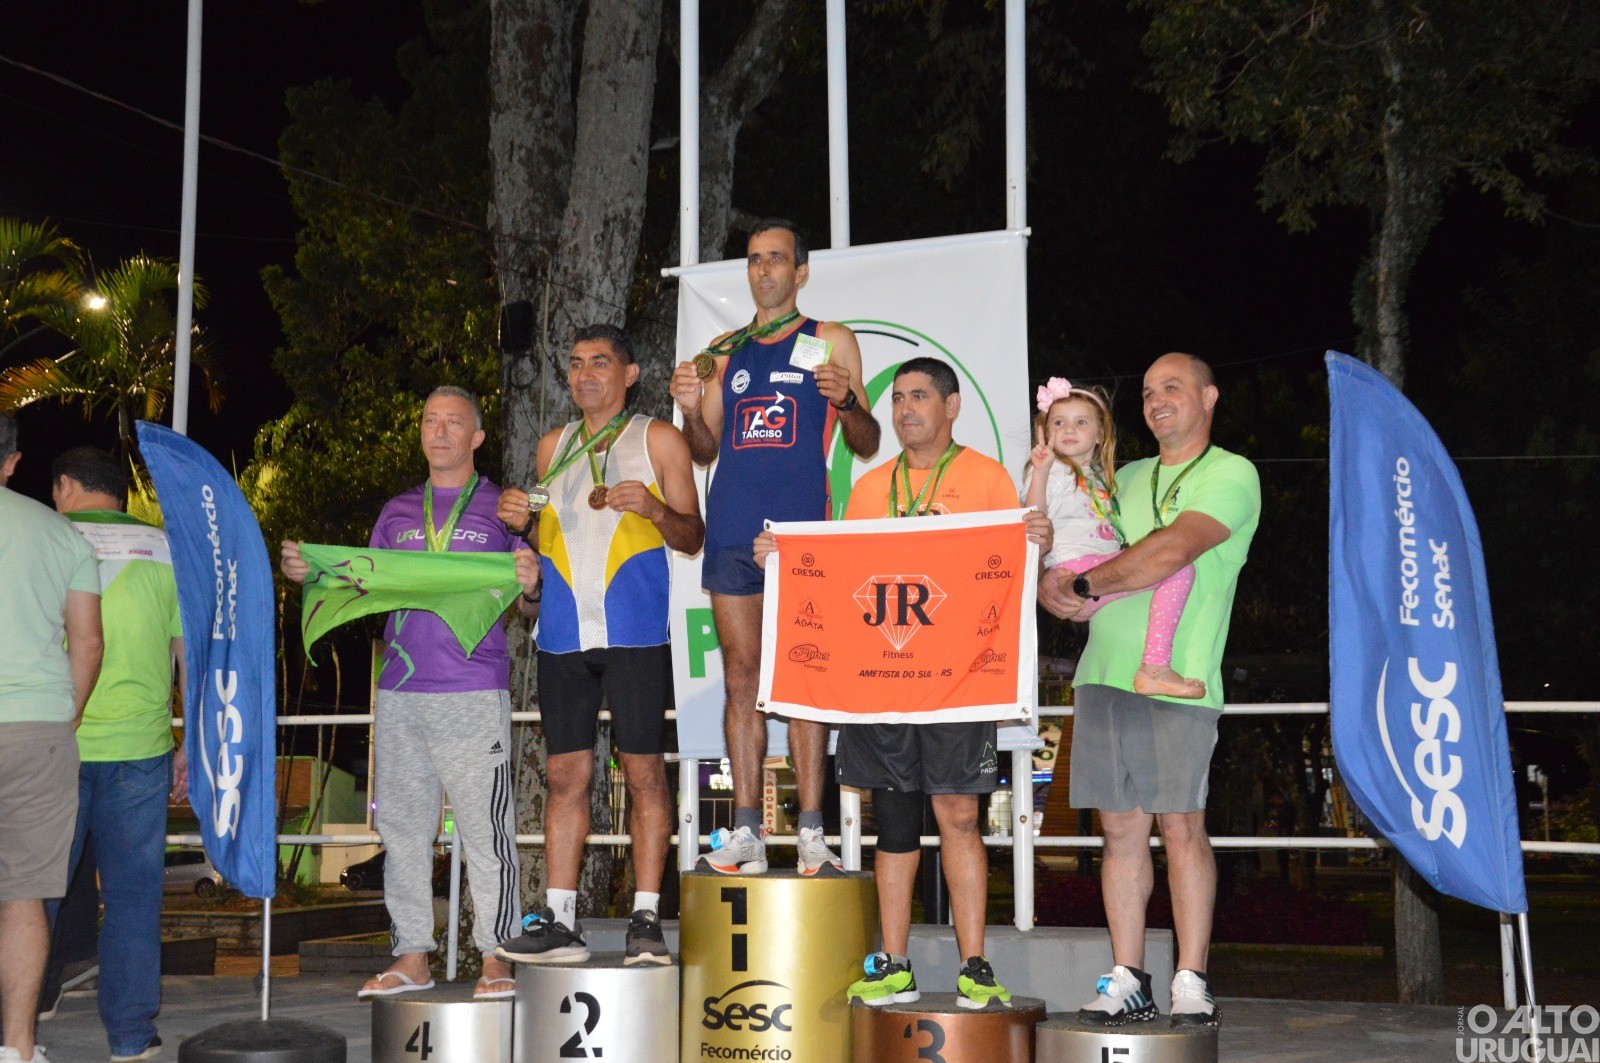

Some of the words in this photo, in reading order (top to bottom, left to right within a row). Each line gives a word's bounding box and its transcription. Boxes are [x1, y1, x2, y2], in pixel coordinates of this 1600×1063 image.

[742, 405, 786, 430] TAG
[742, 429, 782, 439] TARCISO
[1395, 457, 1420, 627] Fecomércio
[202, 484, 225, 640] Fecomércio
[792, 567, 826, 578] CRESOL
[975, 570, 1012, 580] CRESOL
[228, 558, 239, 641] Senac
[863, 582, 935, 626] JR
[1429, 538, 1455, 631] Senac
[794, 616, 824, 631] ÁGATA
[859, 669, 900, 678] AMETISTA
[902, 670, 915, 678] DO
[918, 670, 932, 678] SUL
[940, 669, 952, 677] RS
[883, 650, 914, 659] Fitness
[721, 887, 747, 971] 1
[405, 1021, 433, 1060] 4
[559, 992, 603, 1058] 2
[904, 1019, 947, 1063] 3
[701, 1043, 792, 1061] Fecomércio
